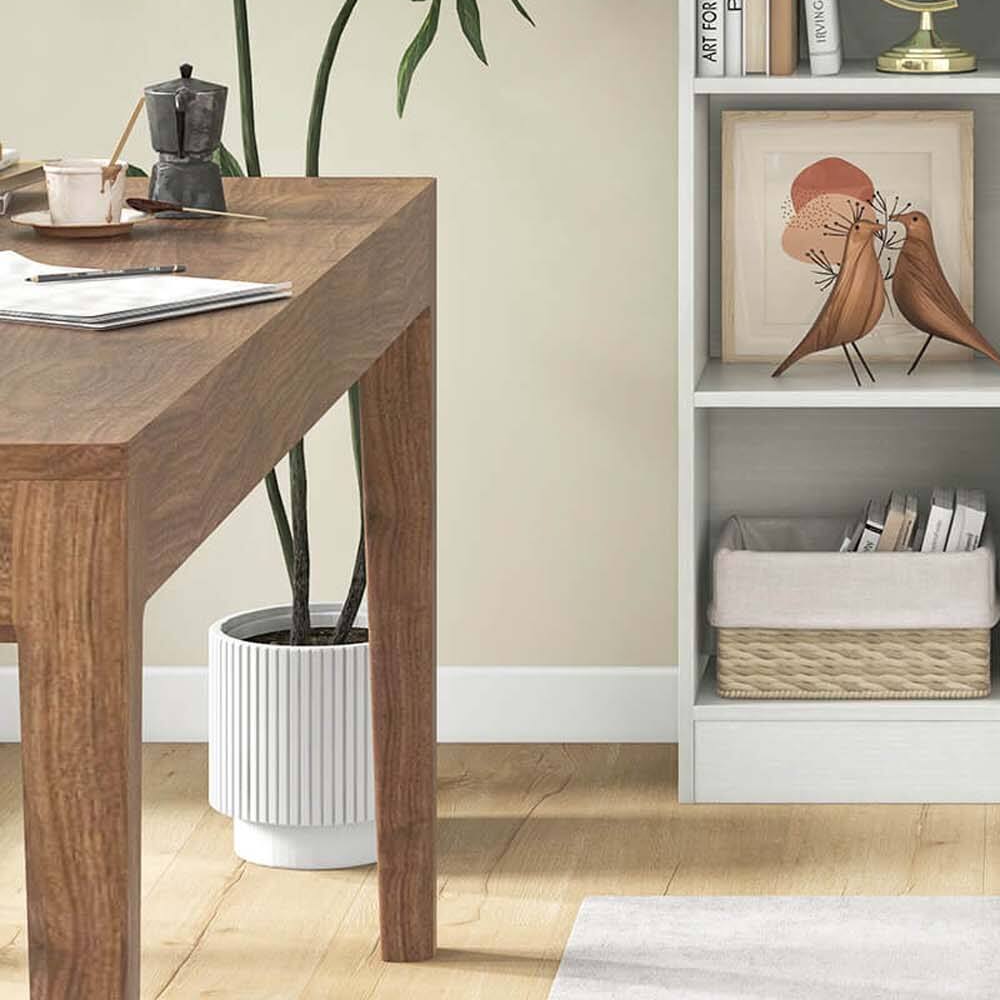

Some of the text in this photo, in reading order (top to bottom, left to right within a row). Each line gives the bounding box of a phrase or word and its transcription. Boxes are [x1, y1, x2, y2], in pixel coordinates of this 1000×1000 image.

[701, 1, 717, 30] FOR
[812, 0, 828, 43] IRVING
[701, 35, 717, 63] ART
